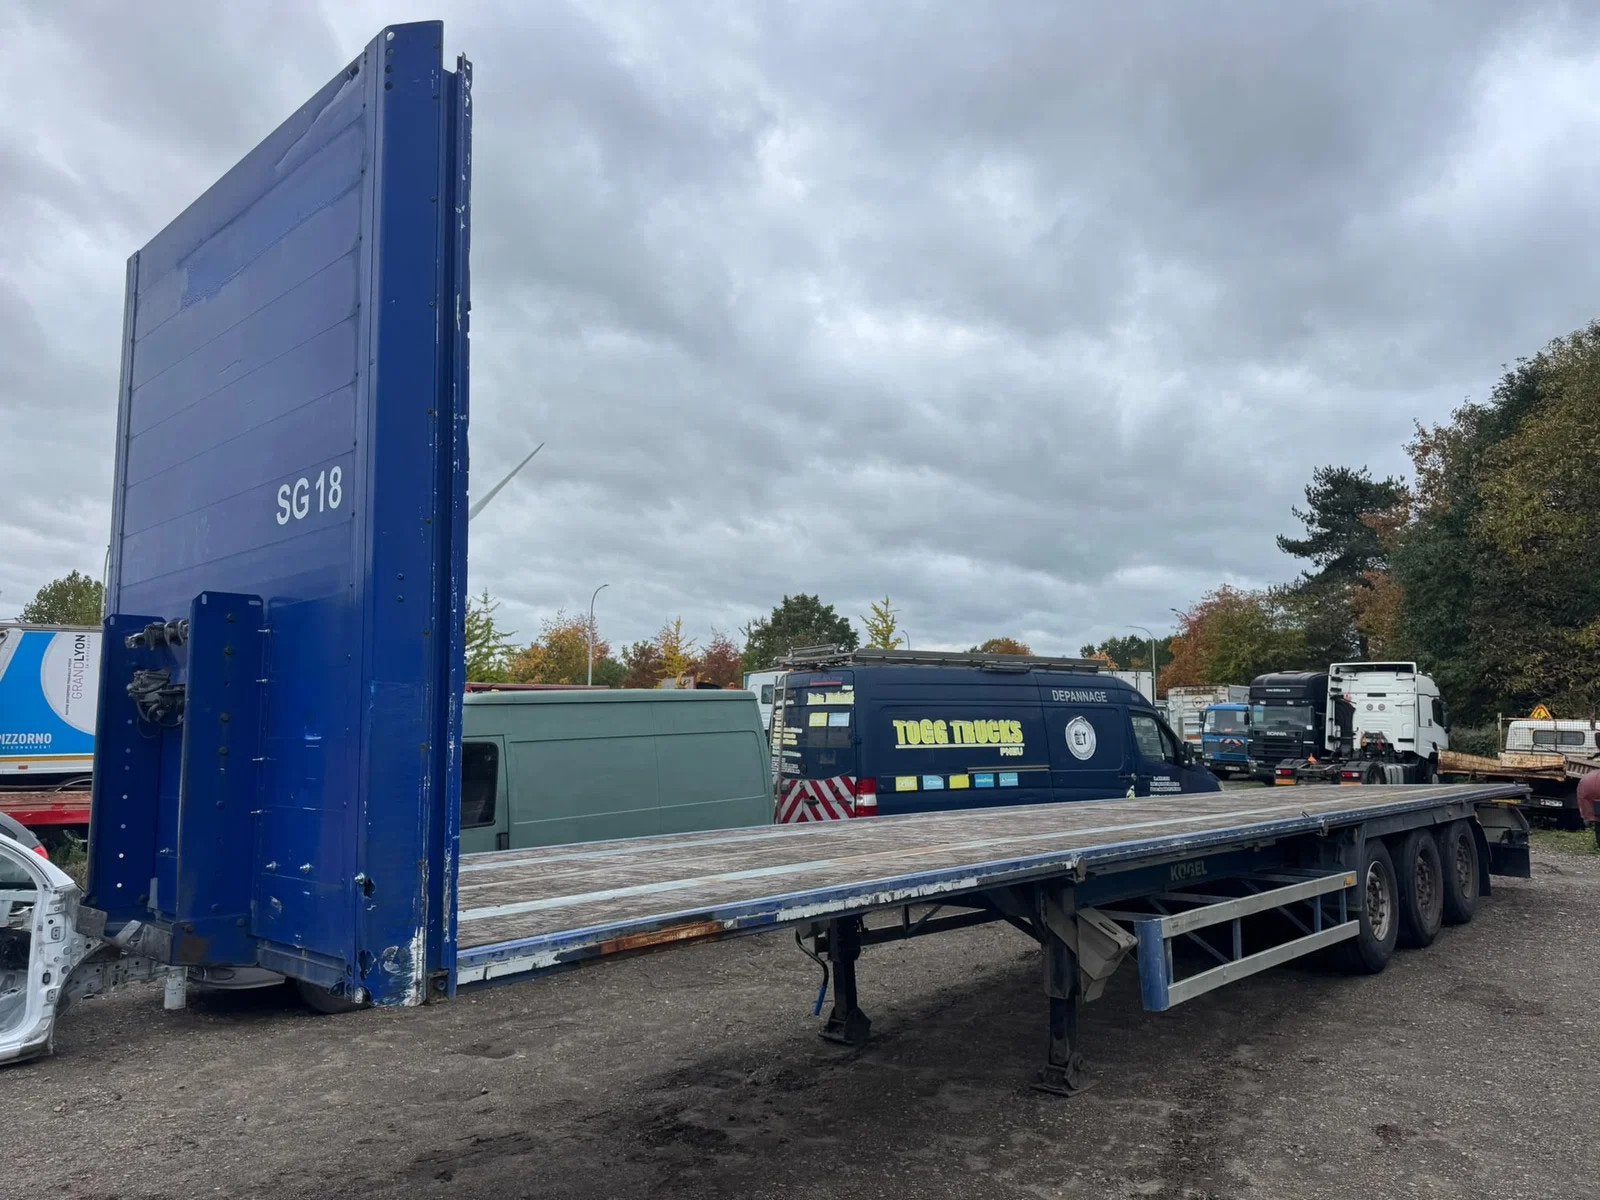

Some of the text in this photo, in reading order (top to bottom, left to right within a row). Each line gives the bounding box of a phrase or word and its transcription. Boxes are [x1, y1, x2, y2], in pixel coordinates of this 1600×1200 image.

[276, 465, 342, 525] SG 18
[1052, 689, 1108, 703] DEPANNAGE
[0, 733, 52, 745] IZZORNO
[892, 718, 1024, 745] TOGG TRUCKS
